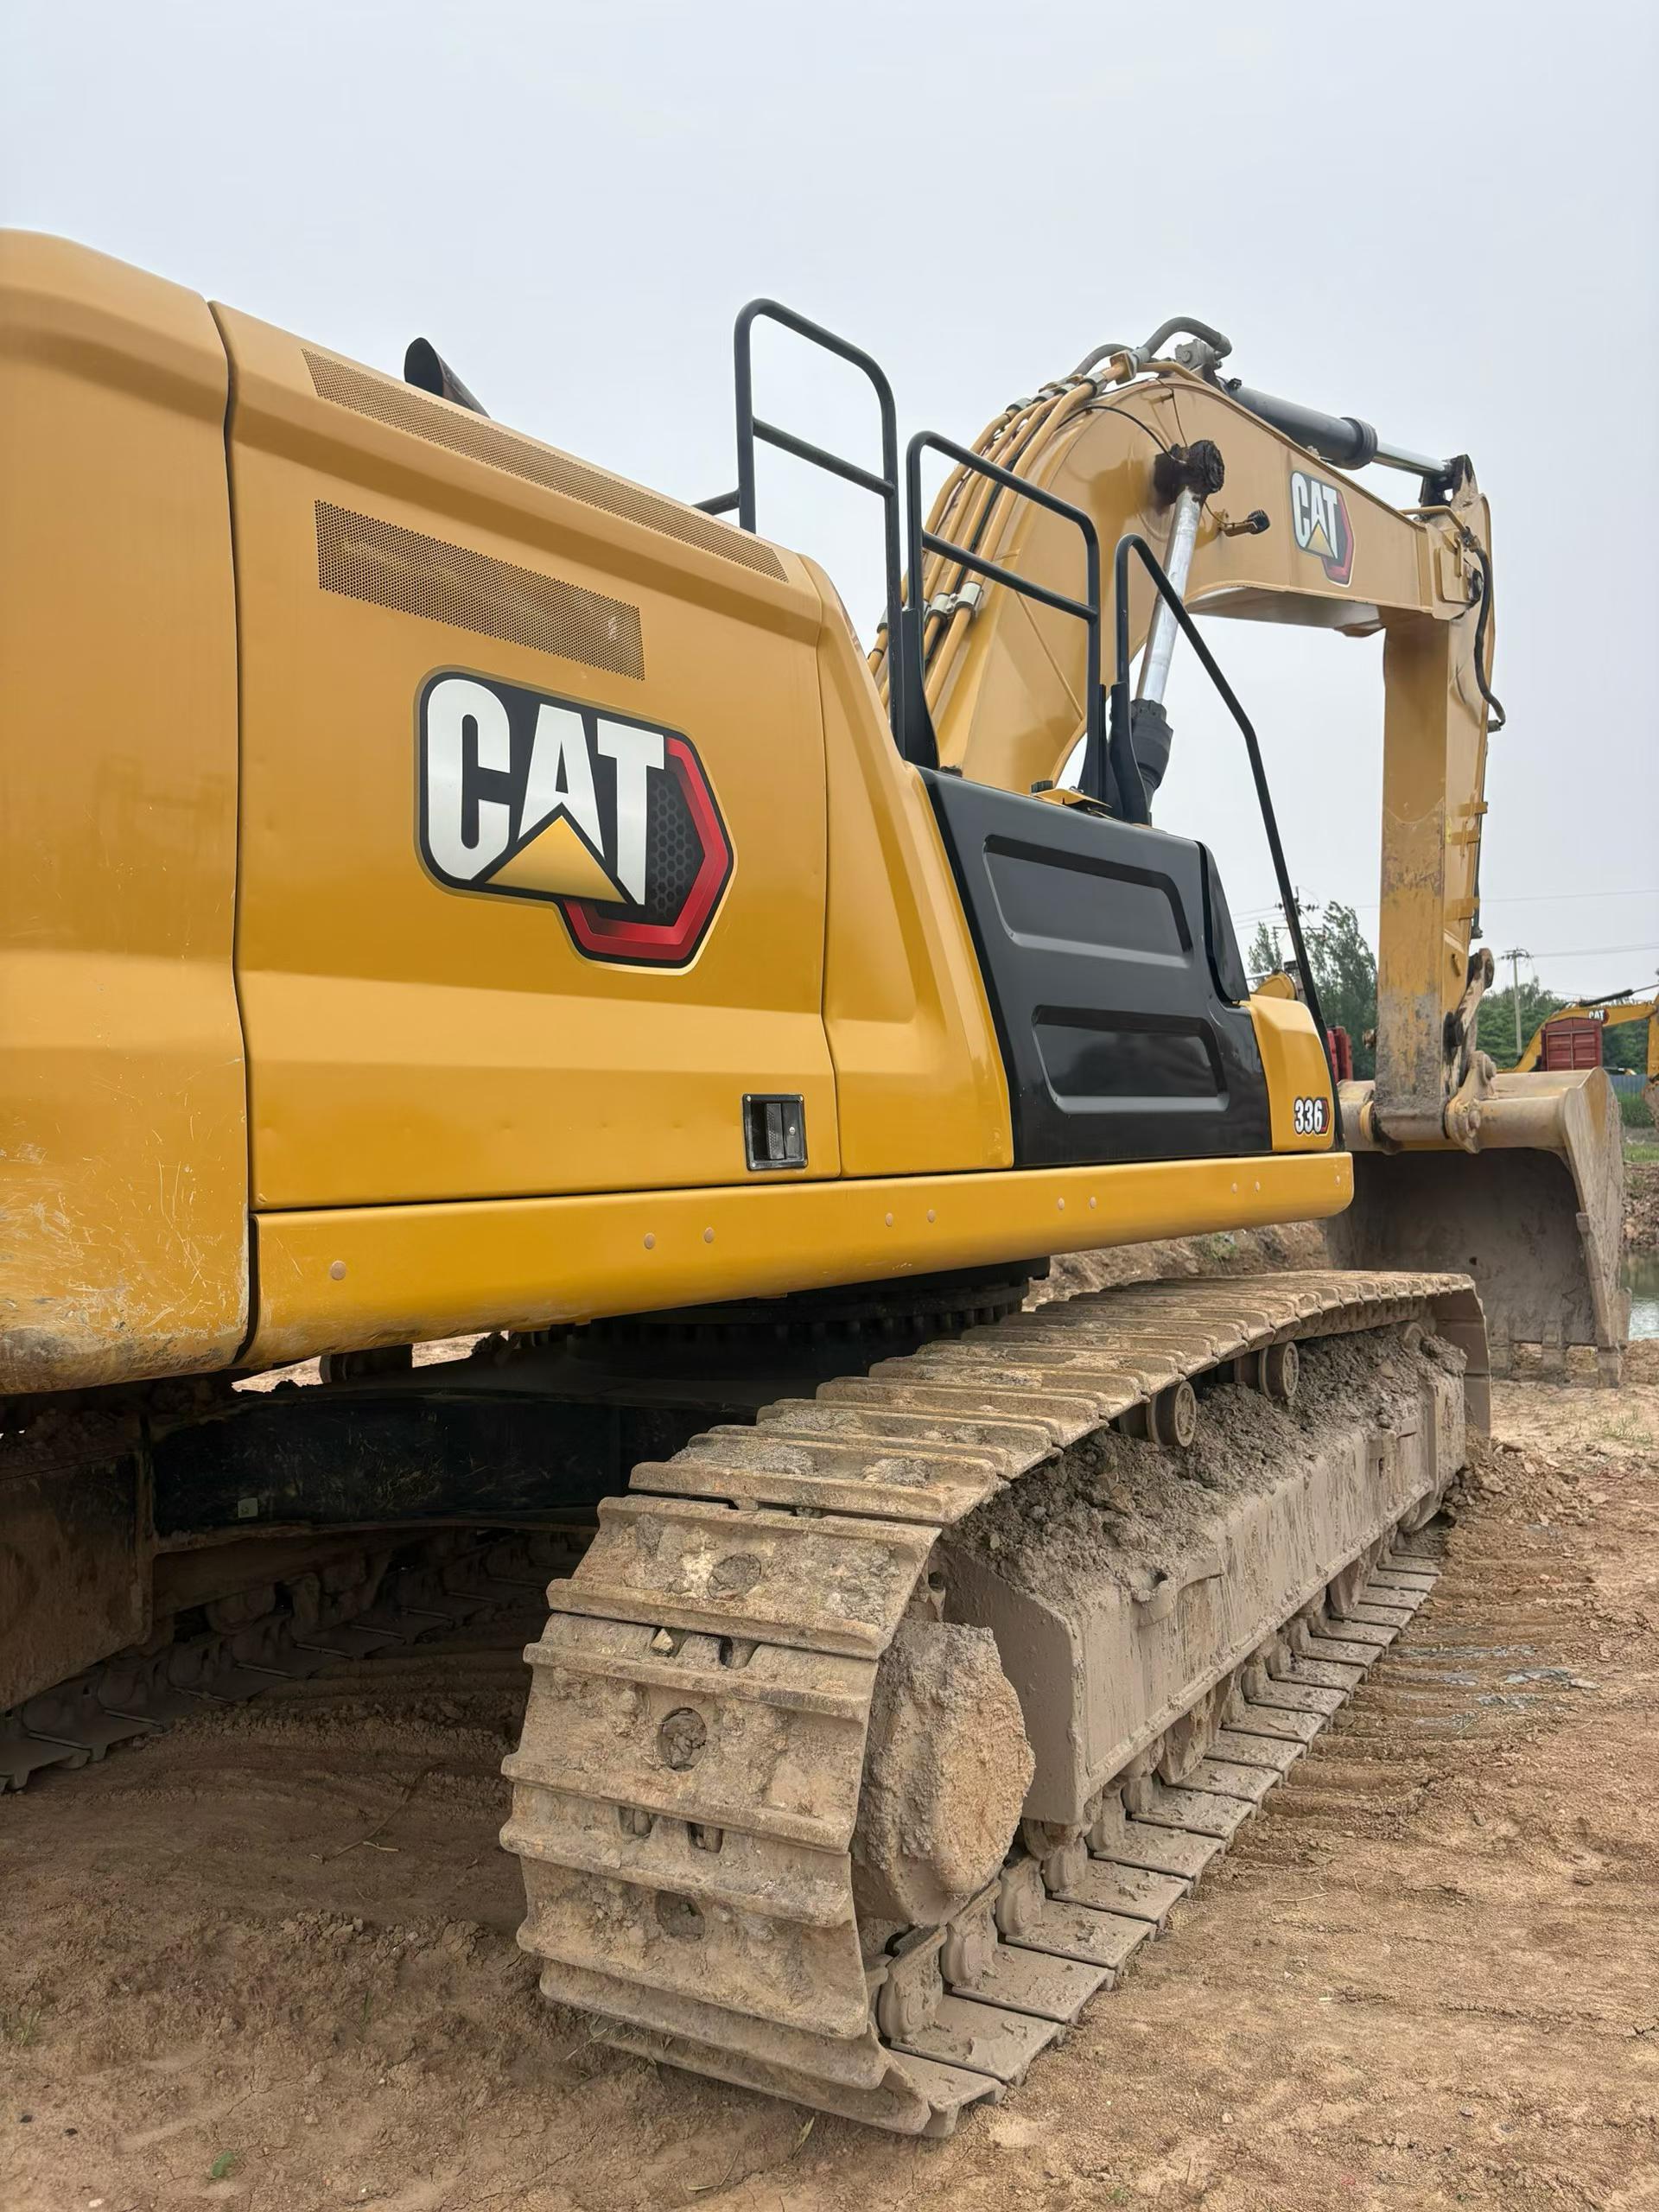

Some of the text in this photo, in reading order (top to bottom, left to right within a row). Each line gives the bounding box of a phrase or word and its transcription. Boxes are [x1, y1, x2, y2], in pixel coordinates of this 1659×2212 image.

[1292, 472, 1338, 559] CAT
[428, 679, 664, 906] CAT
[1294, 1099, 1323, 1133] 336
